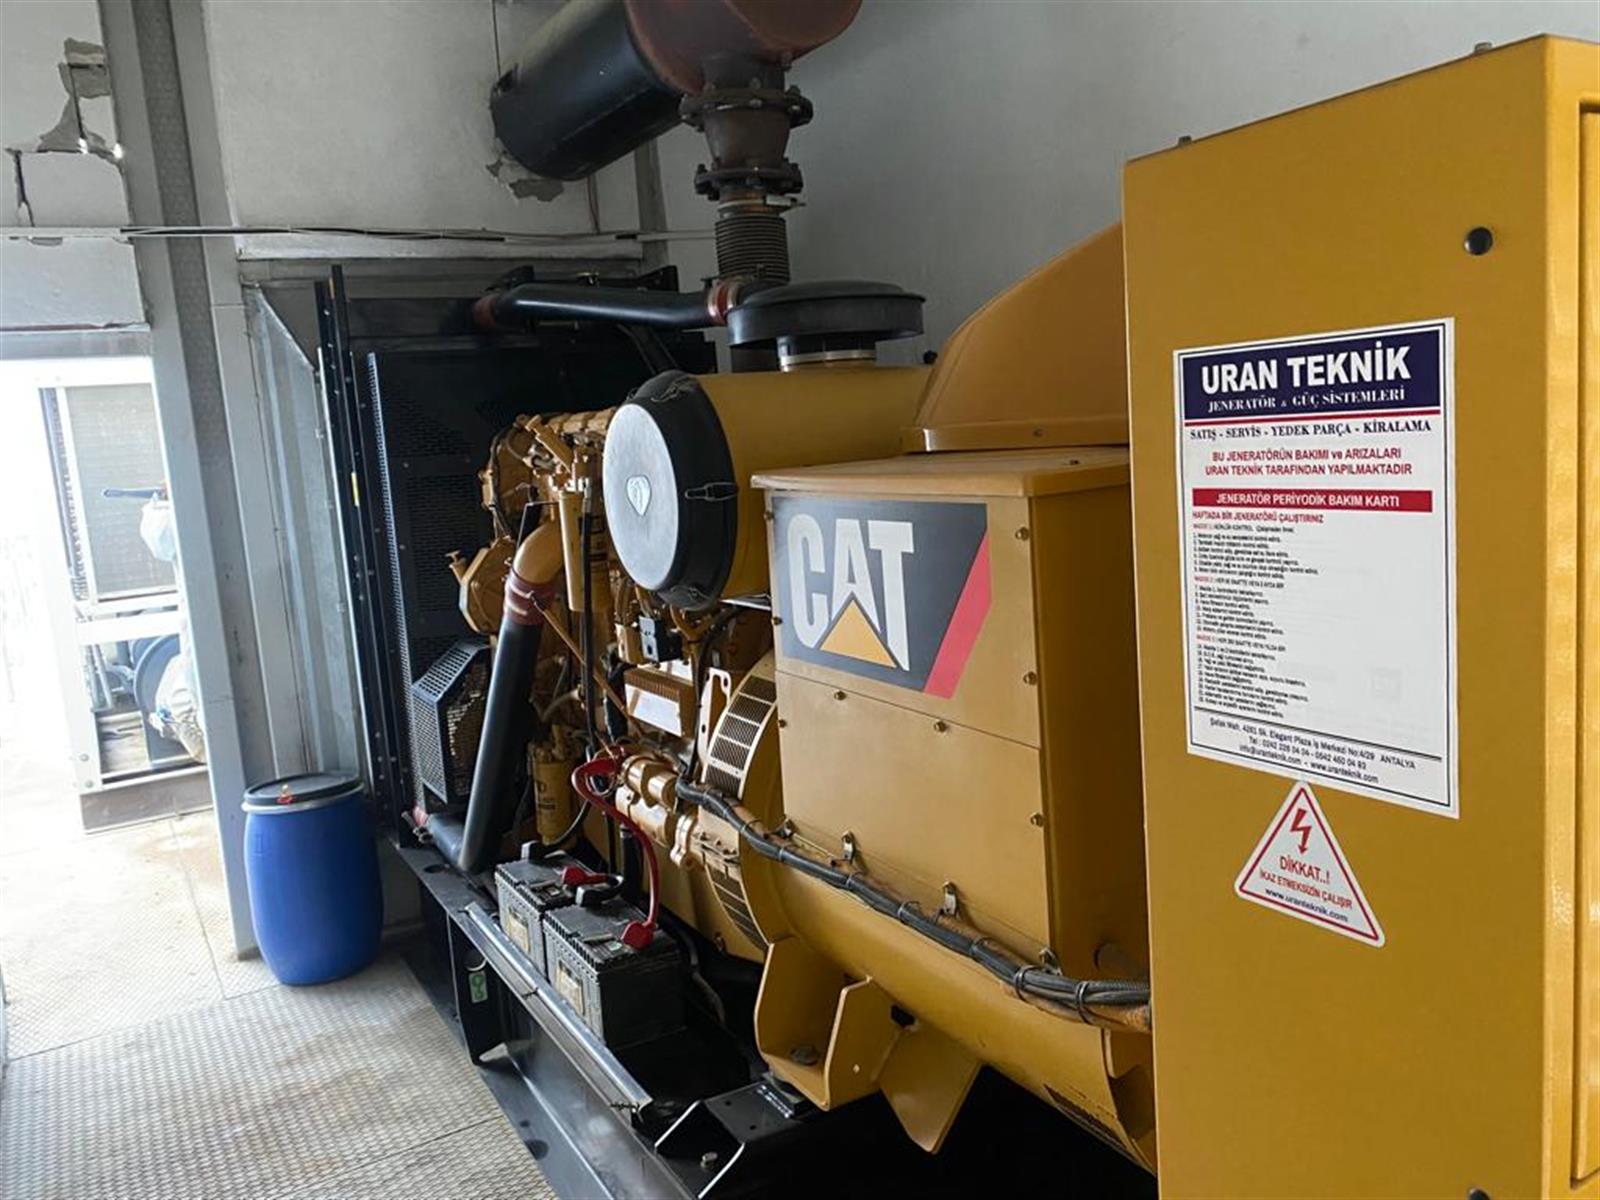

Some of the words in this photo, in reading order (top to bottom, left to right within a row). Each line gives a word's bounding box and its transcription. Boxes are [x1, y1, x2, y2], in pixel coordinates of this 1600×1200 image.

[1201, 358, 1278, 395] URAN
[1286, 340, 1411, 388] TEKNİK
[1207, 394, 1276, 413] JENERATÖR
[1292, 391, 1319, 408] GÜÇ
[1322, 384, 1404, 405] SİSTEMLERİ
[1190, 429, 1216, 441] SATIŞ
[1225, 425, 1260, 439] SERVİS
[1271, 424, 1309, 437] YEDEK
[1313, 423, 1350, 436] PARÇA
[1363, 419, 1430, 434] KİRALAMA
[1213, 451, 1224, 461] BU
[1226, 448, 1292, 461] JENERATÖRÜN
[1295, 448, 1328, 460] BAKIMI
[1331, 450, 1342, 459] ve
[1345, 446, 1401, 459] ARIZALARI
[1205, 465, 1228, 475] URAN
[1232, 463, 1263, 474] TEKNİK
[1265, 464, 1325, 474] TARAFINDAN
[1327, 462, 1412, 474] YAPILMAKTADIR
[1216, 491, 1270, 504] JENERATÖR
[1272, 492, 1326, 505] PERİYODİK
[1328, 494, 1362, 505] BAKIM
[1365, 495, 1398, 506] KARTI
[787, 514, 915, 672] CAT
[1380, 753, 1415, 769] ANTALYA
